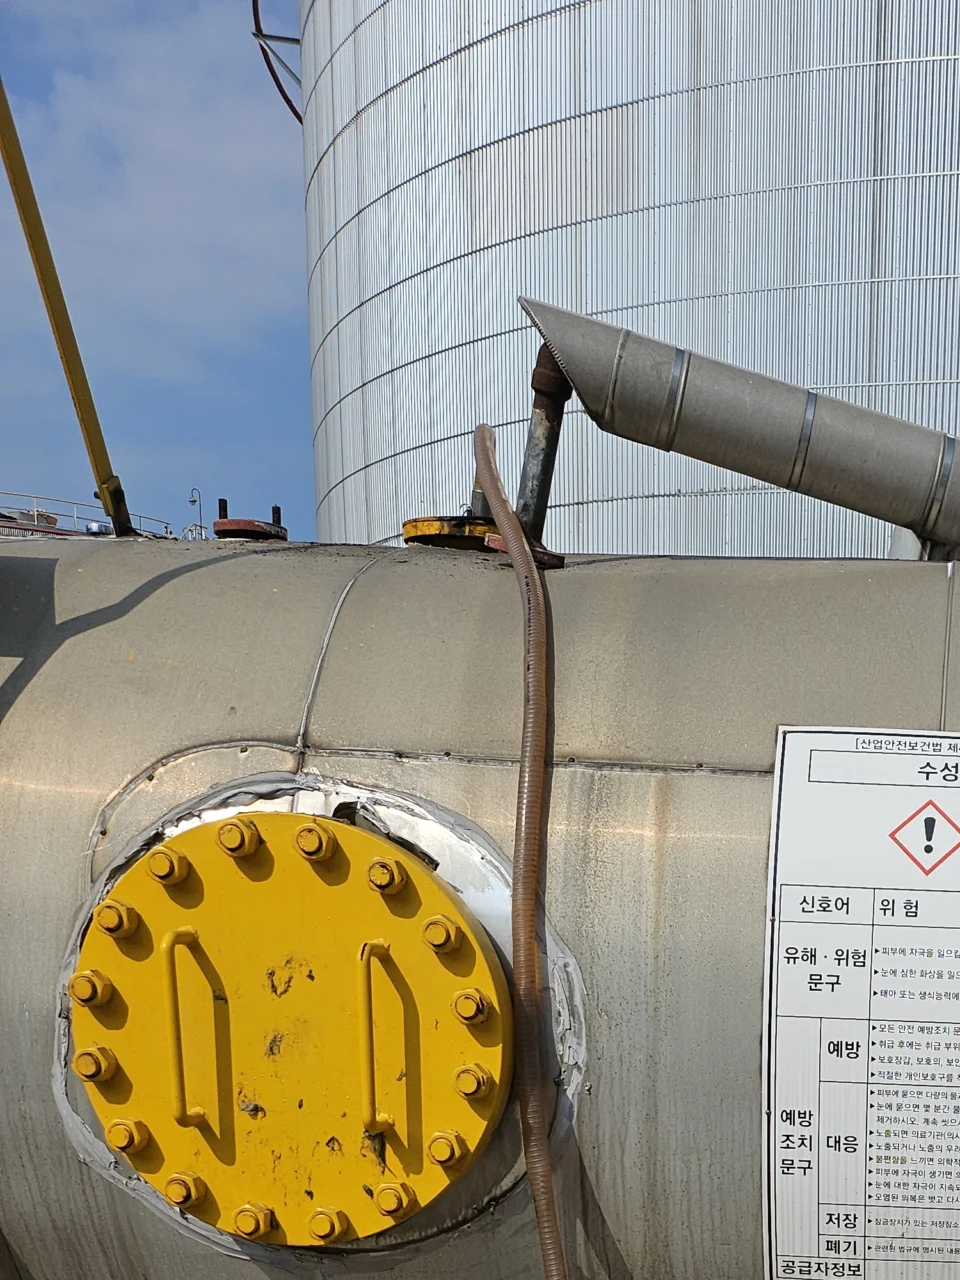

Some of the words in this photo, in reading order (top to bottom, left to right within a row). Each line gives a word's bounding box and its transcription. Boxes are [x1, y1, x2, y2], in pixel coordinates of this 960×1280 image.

[799, 895, 850, 916] 신호어
[782, 946, 817, 966] 유해
[833, 948, 867, 968] 위험
[881, 947, 907, 957] 피부에
[908, 947, 934, 958] 자극을
[880, 967, 898, 978] 눈에
[900, 968, 917, 979] 심한
[919, 969, 945, 980] 화상을
[807, 973, 842, 993] 문구
[880, 989, 897, 999] 태아
[898, 990, 916, 1000] 또는
[918, 990, 960, 1002] 생식능력에
[878, 1023, 895, 1034] 모든
[897, 1024, 915, 1035] 안전
[917, 1025, 950, 1036] 예방조치
[827, 1040, 862, 1060] 예방
[878, 1039, 895, 1049] 취급
[897, 1039, 923, 1051] 후에는
[925, 1041, 942, 1051] 취급
[878, 1055, 914, 1067] 보호장갑,
[915, 1056, 943, 1068] 보호의,
[877, 1070, 903, 1081] 적절한
[904, 1071, 954, 1083] 개인보호구를
[876, 1088, 900, 1098] 피부에
[901, 1089, 924, 1099] 묻으면
[876, 1101, 893, 1112] 눈에
[895, 1102, 920, 1113] 묻으면
[933, 1104, 950, 1114] 분간
[780, 1109, 814, 1128] 예방
[875, 1115, 919, 1126] 제거하시오.
[922, 1117, 939, 1127] 계속
[875, 1128, 909, 1139] 노출되면
[779, 1133, 813, 1153] 조치
[826, 1134, 859, 1154] 대응
[875, 1141, 916, 1152] 노출되거나
[918, 1143, 943, 1154] 노출의
[779, 1158, 814, 1177] 문구
[910, 1156, 935, 1166] 느끼면
[875, 1167, 900, 1177] 피부에
[901, 1169, 926, 1179] 자극이
[928, 1170, 953, 1180] 생기면
[874, 1180, 891, 1190] 눈에
[893, 1181, 910, 1191] 대한
[912, 1182, 936, 1192] 자극이
[825, 1212, 859, 1232] 저장
[913, 1219, 928, 1228] 있는
[825, 1239, 857, 1256] 폐기
[780, 1259, 863, 1278] 공급자정보
